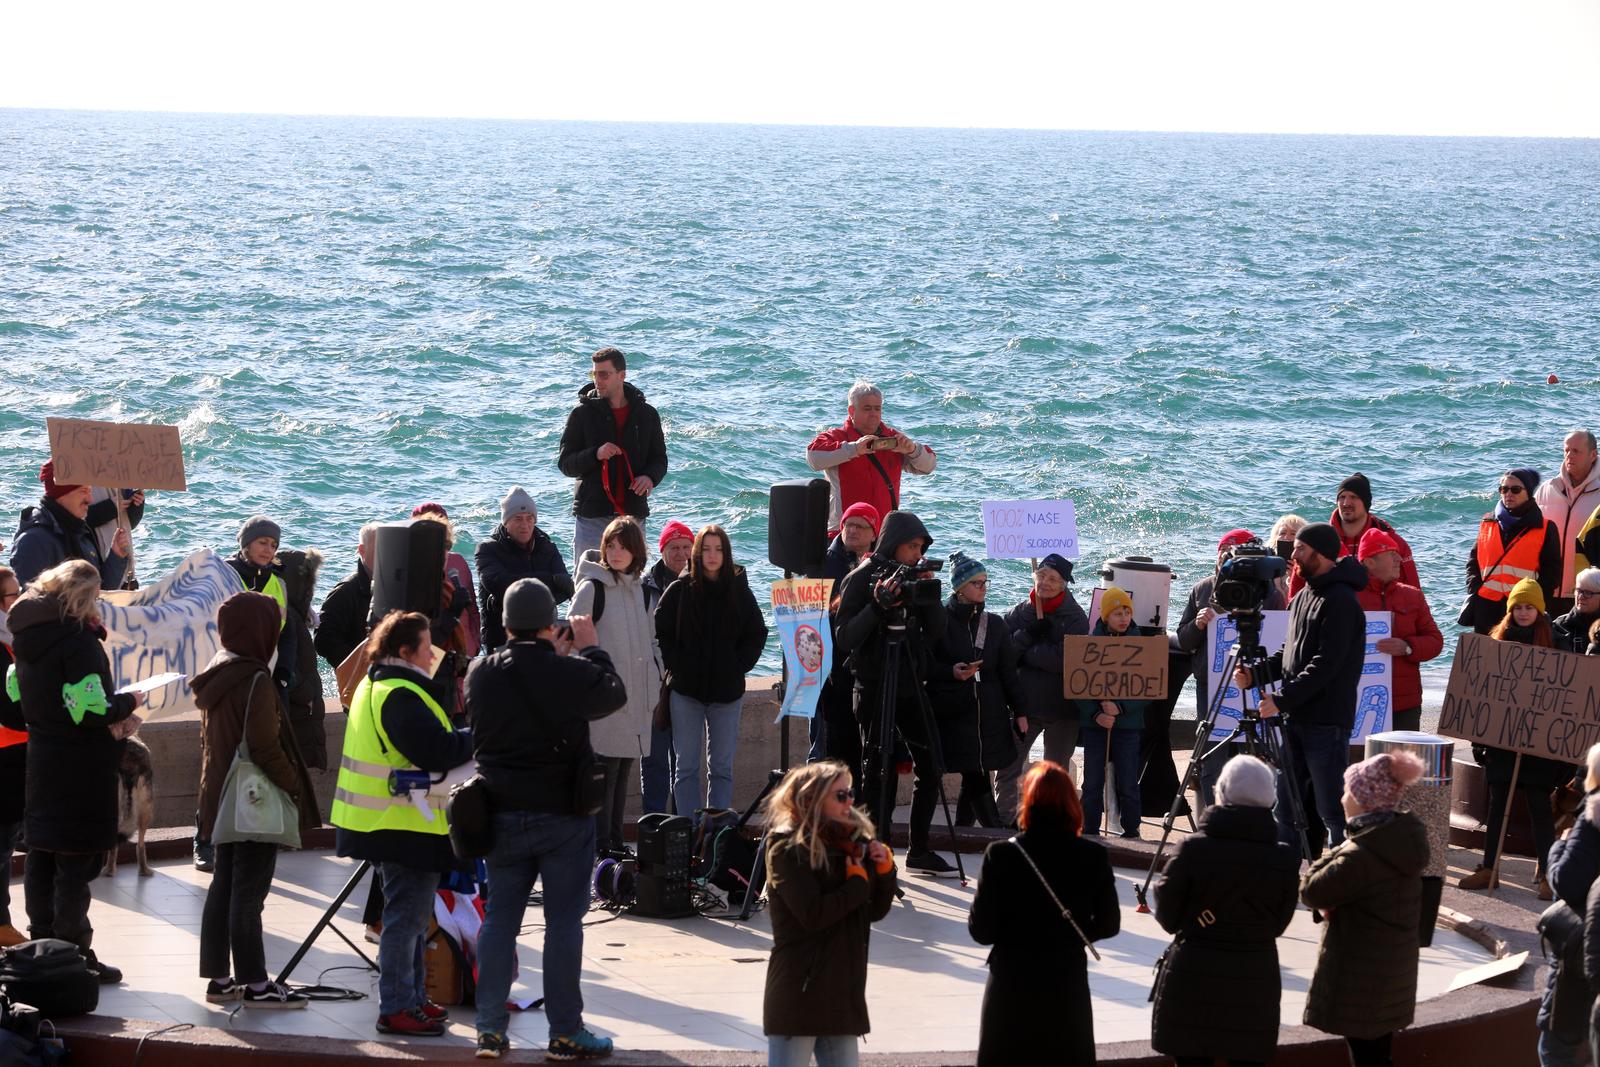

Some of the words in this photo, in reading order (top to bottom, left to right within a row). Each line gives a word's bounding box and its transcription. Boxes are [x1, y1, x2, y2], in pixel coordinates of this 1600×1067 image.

[991, 508, 1024, 528] 100%
[993, 534, 1024, 553] 100%
[772, 587, 797, 606] 100%
[797, 583, 829, 602] NAŠE
[1083, 642, 1143, 666] BEZ
[1460, 635, 1482, 673] VA
[1498, 644, 1578, 687] VRAŽJU
[1069, 668, 1164, 697] OGRADE!
[1464, 671, 1518, 704] MATER
[1439, 692, 1491, 738] DAMO
[1498, 706, 1545, 749] NAŠE
[1547, 717, 1600, 759] GROT
